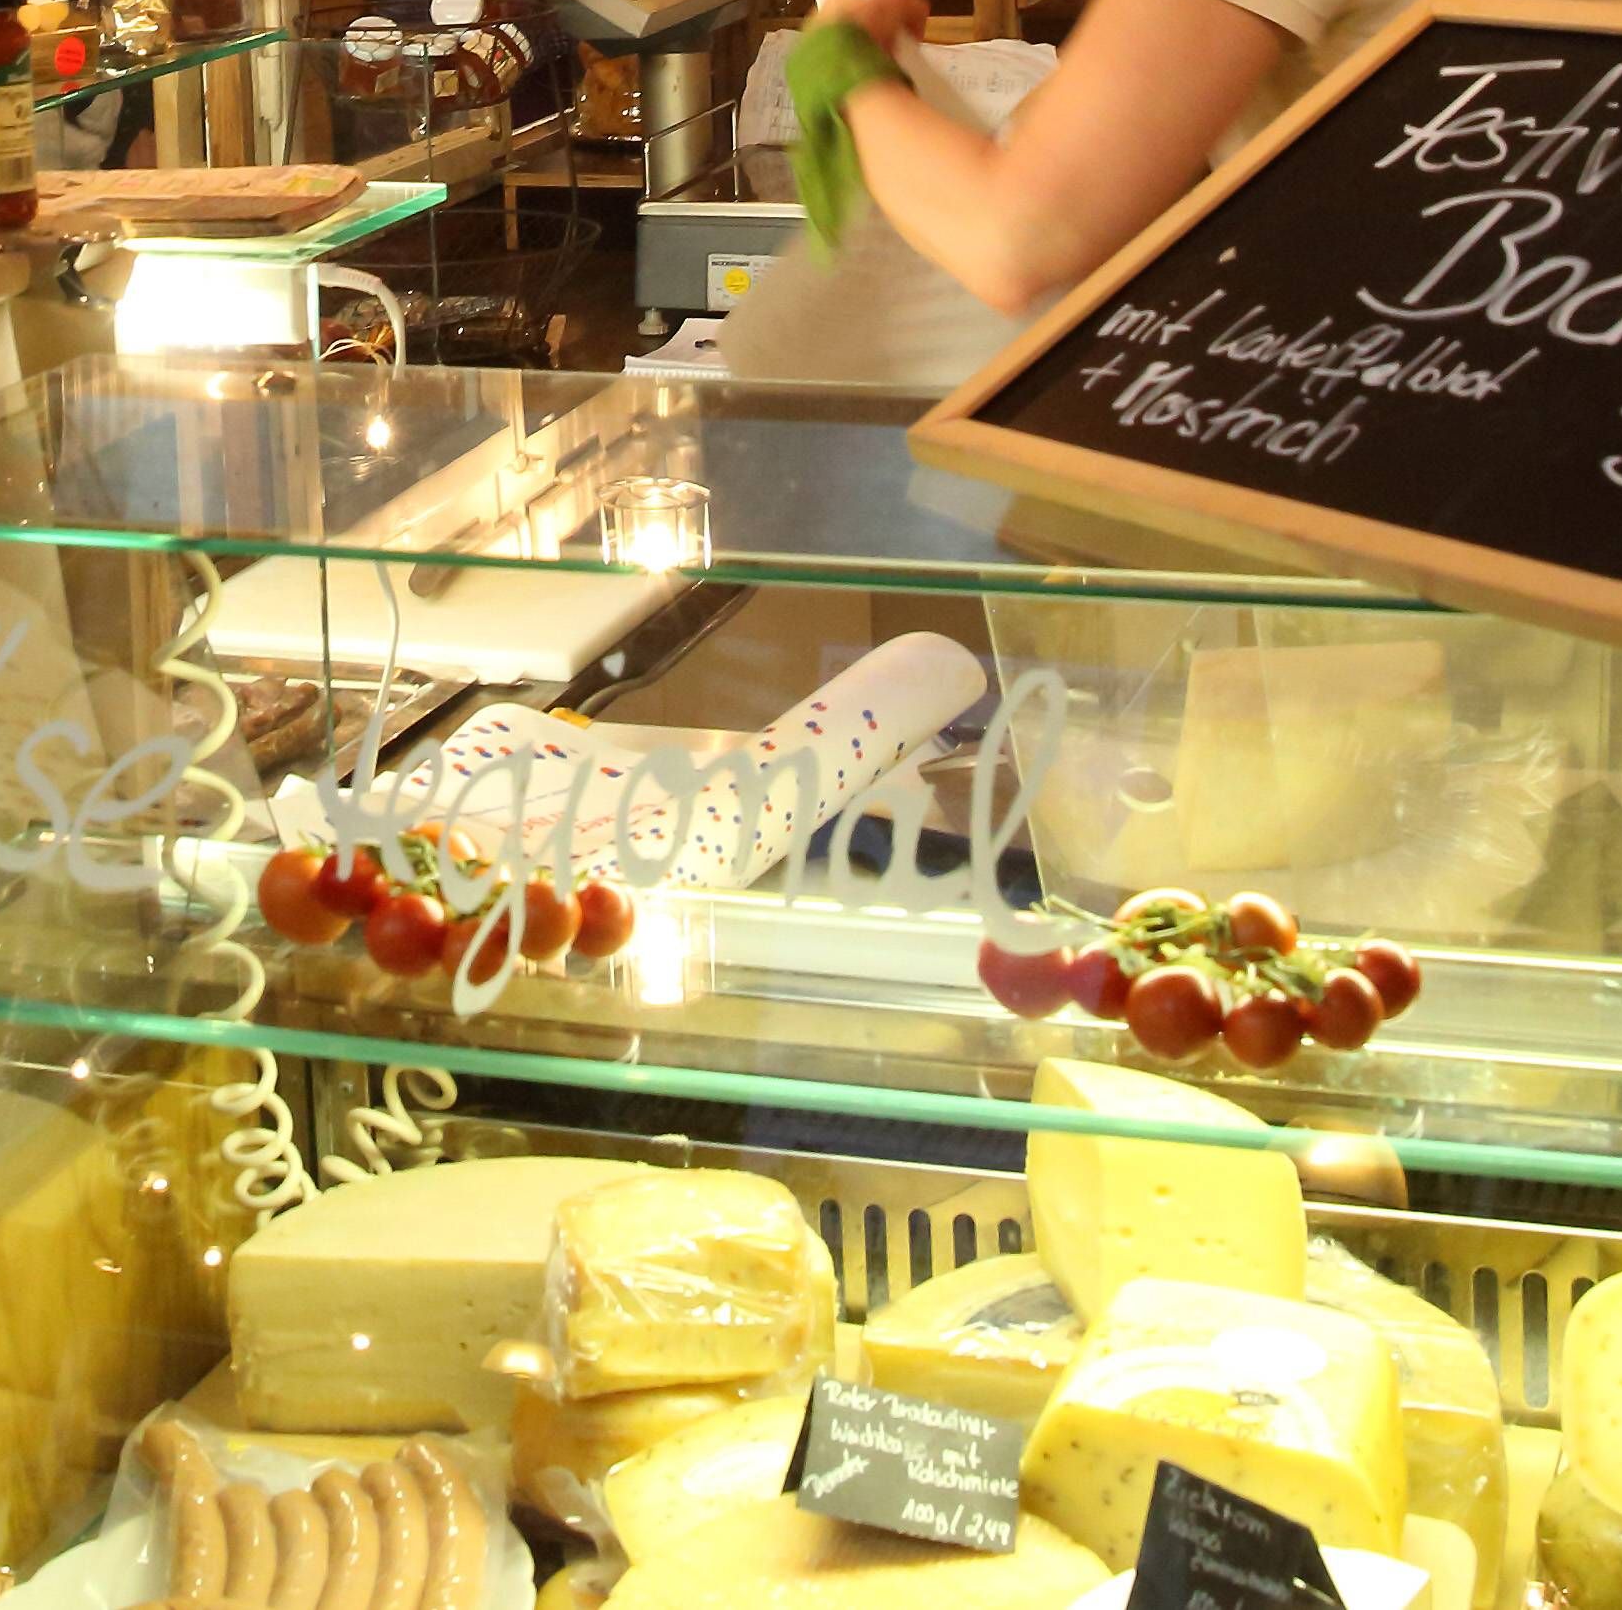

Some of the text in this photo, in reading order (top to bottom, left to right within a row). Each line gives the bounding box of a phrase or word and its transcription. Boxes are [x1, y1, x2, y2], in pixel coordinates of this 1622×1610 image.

[1096, 288, 1227, 346] mit
[314, 665, 1114, 1018] regional
[942, 1441, 981, 1470] mit
